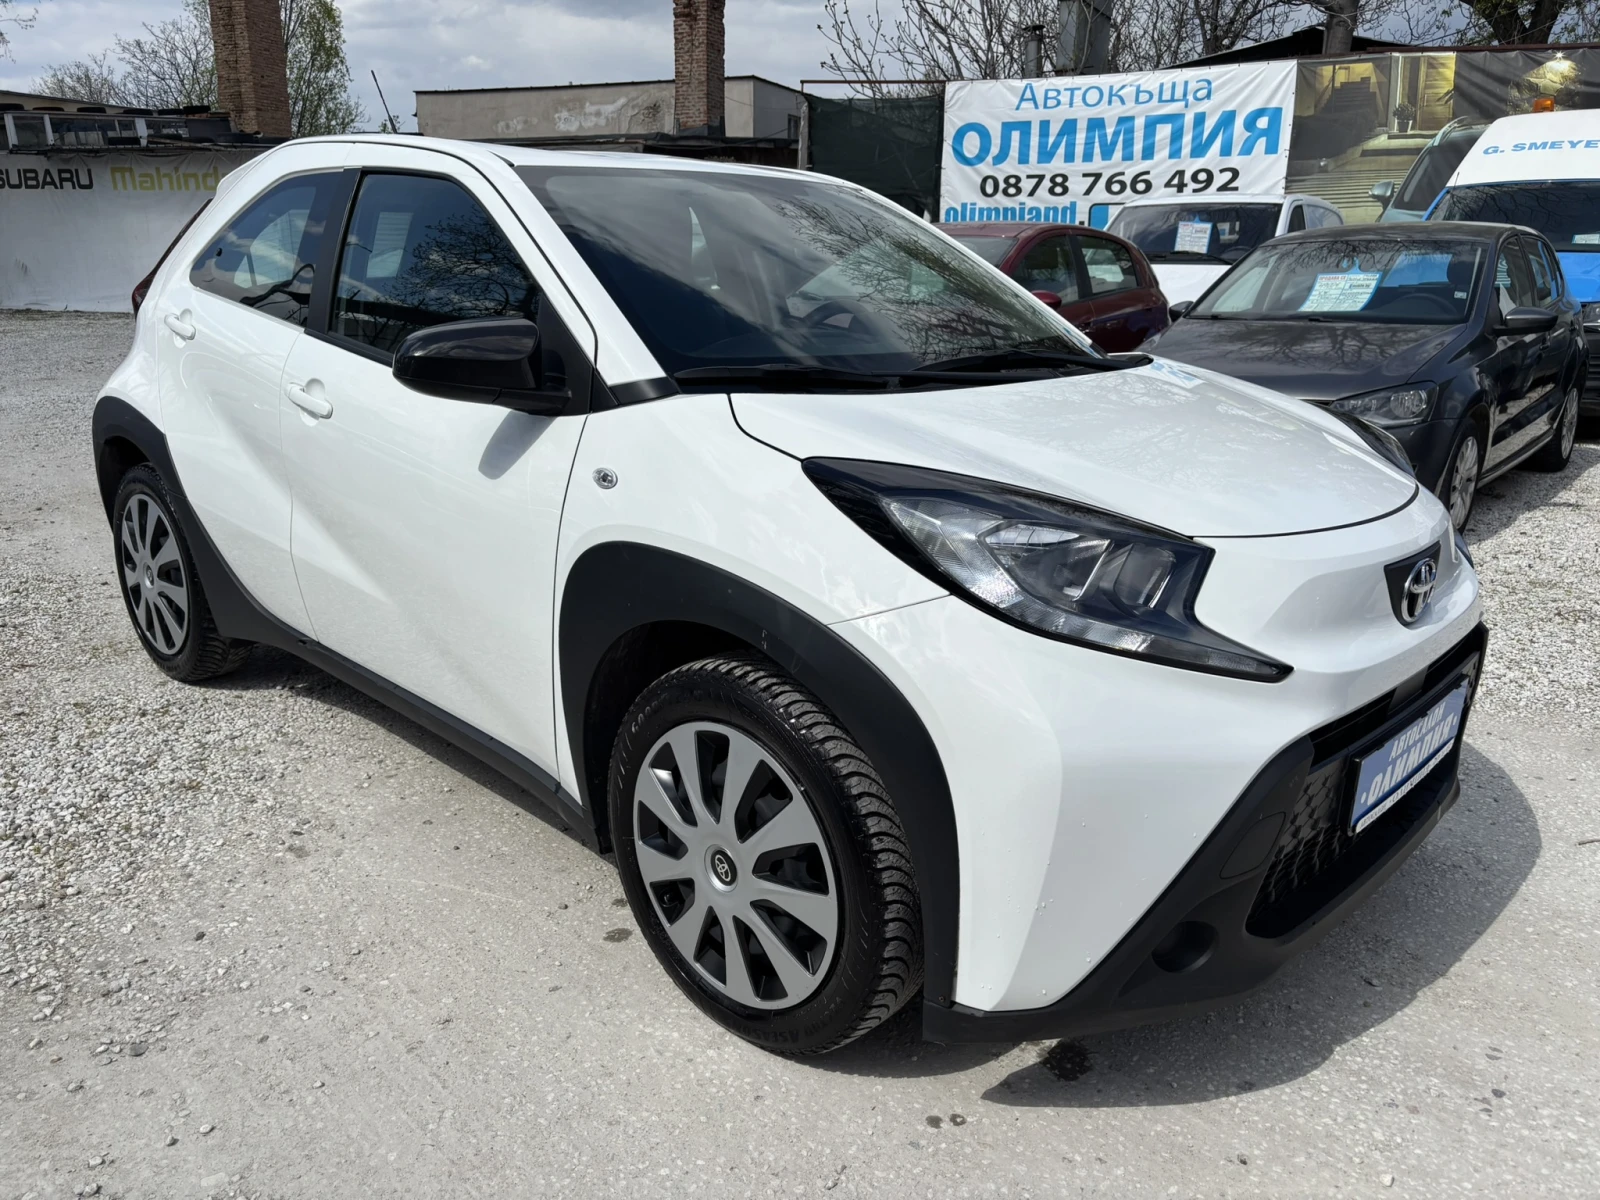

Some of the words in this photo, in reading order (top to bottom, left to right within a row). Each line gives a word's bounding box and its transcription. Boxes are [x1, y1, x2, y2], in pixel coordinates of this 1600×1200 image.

[1015, 78, 1213, 111] Автокъща
[951, 106, 1284, 167] ОЛИМПИЯ
[1482, 146, 1505, 155] G.
[110, 166, 219, 192] Mahind
[979, 173, 1070, 198] 0878
[1081, 170, 1153, 196] 766
[1163, 168, 1241, 194] 492
[1389, 702, 1446, 762] АВТОСАЛОН
